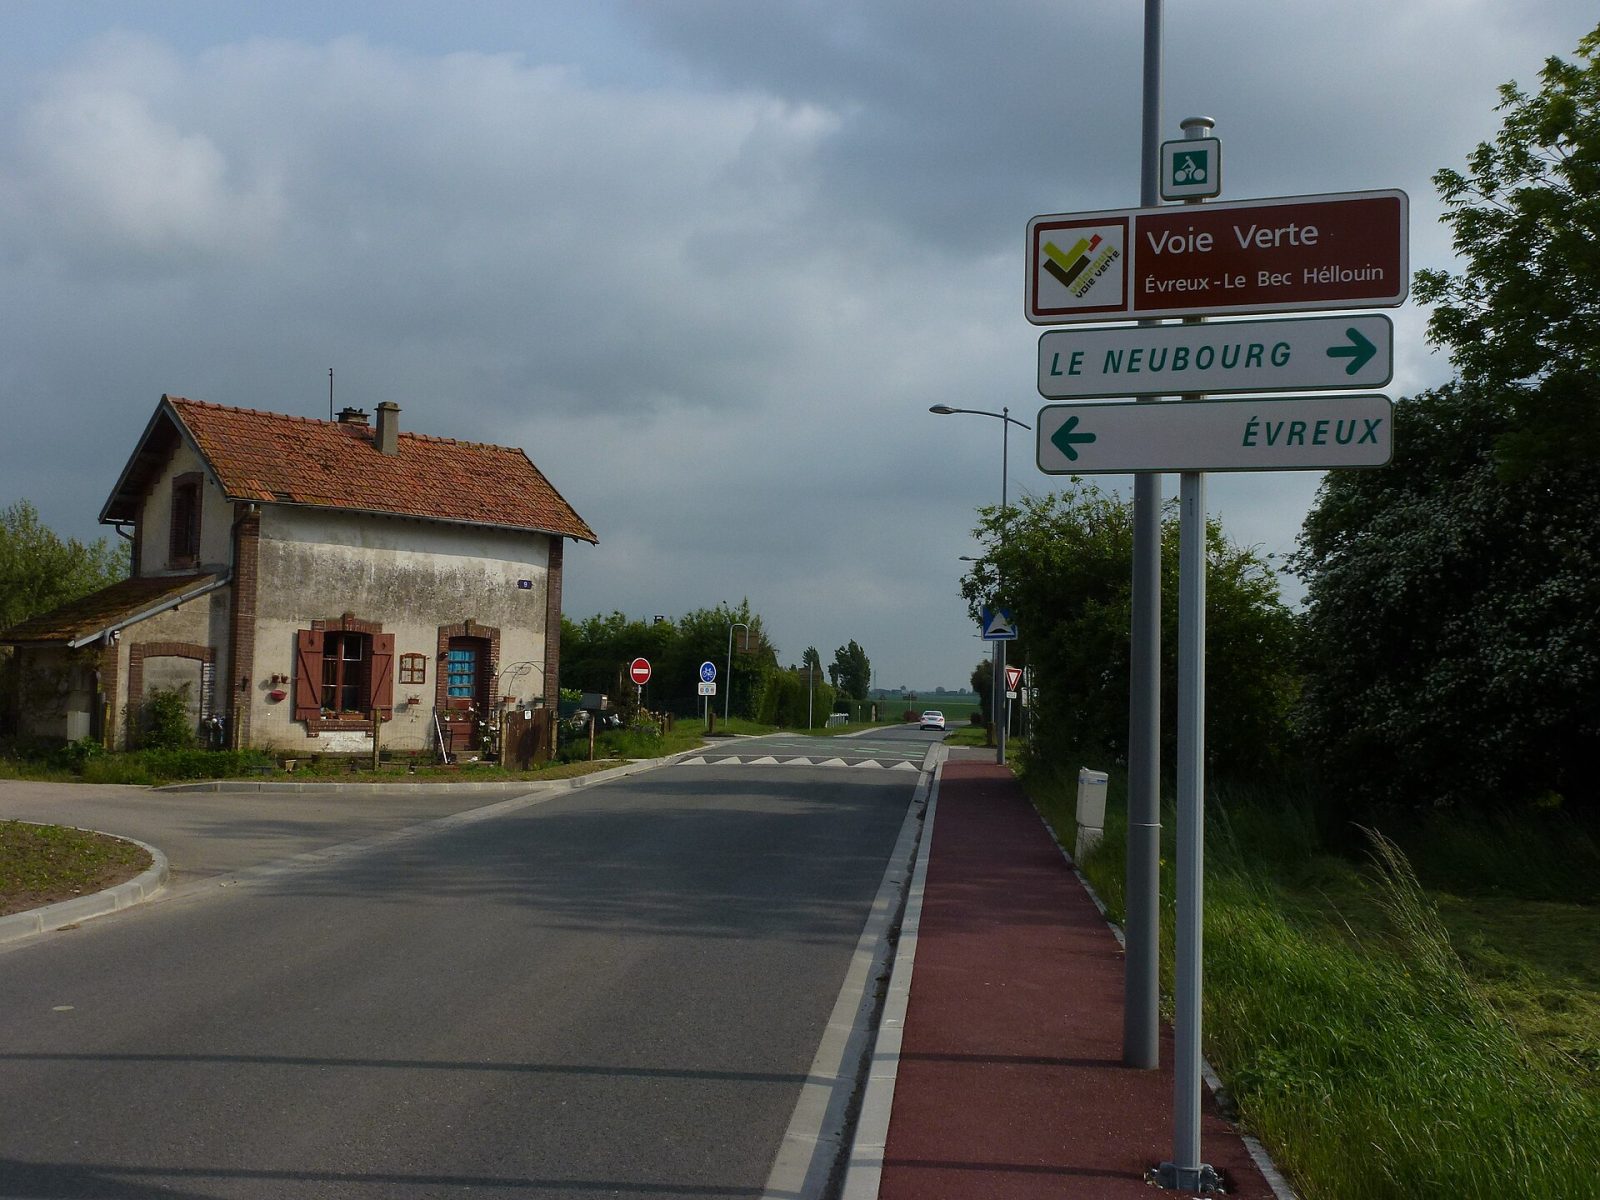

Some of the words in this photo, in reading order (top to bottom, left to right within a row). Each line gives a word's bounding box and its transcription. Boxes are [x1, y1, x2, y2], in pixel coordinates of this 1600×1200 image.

[1146, 226, 1214, 255] Voie
[1233, 222, 1319, 250] Verte
[1075, 278, 1096, 298] voie
[1095, 250, 1121, 277] verte
[1258, 270, 1293, 287] Bec
[1303, 264, 1385, 285] Héllouin
[1049, 351, 1085, 376] LE
[1102, 342, 1292, 375] NEUBOURG
[1242, 416, 1383, 447] ÉVREUX
